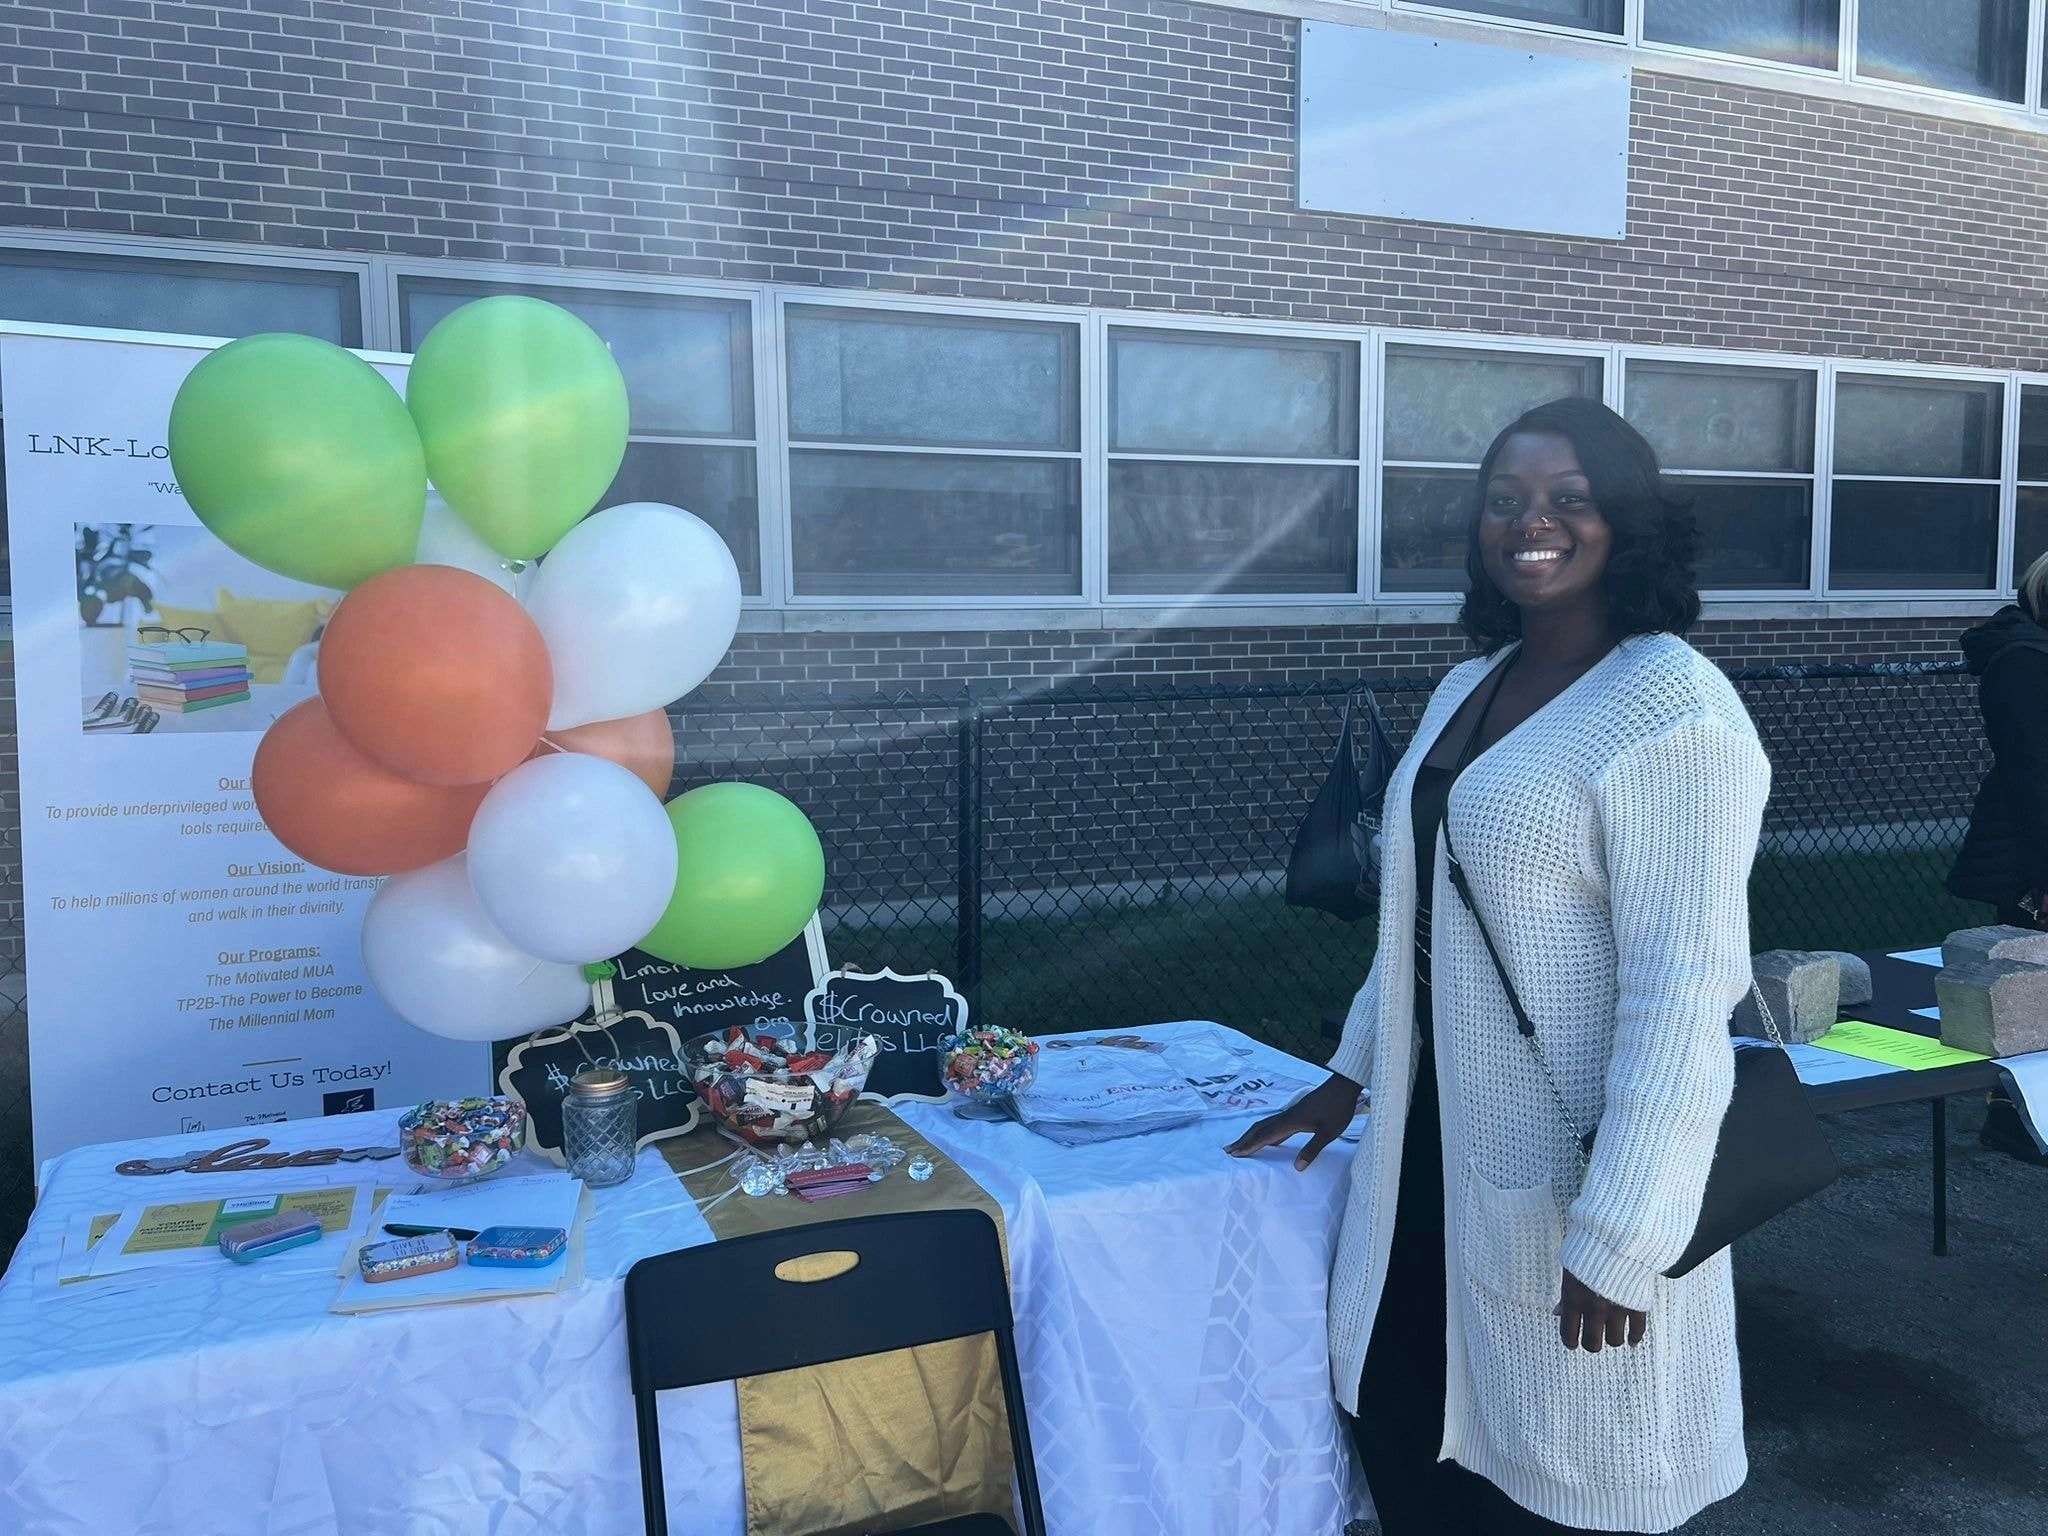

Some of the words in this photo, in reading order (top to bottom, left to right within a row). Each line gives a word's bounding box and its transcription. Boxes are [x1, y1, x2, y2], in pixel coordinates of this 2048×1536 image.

[218, 777, 245, 791] Our
[46, 806, 61, 819] To
[66, 804, 118, 821] provide
[123, 799, 228, 819] underprivileged
[180, 822, 211, 835] tools
[228, 863, 253, 877] Our
[257, 861, 306, 876] Vision:
[51, 896, 66, 909] To
[71, 894, 100, 910] help
[106, 891, 158, 907] millions
[163, 889, 177, 904] of
[180, 889, 228, 900] women
[233, 883, 278, 898] around
[282, 881, 302, 895] the
[306, 878, 340, 893] world
[188, 908, 213, 923] and
[217, 906, 248, 920] walk
[251, 906, 263, 918] in
[267, 902, 296, 917] their
[300, 900, 345, 915] divinity.
[217, 951, 244, 965] Our
[249, 946, 320, 962] Programs:
[206, 973, 231, 987] The
[235, 967, 299, 985] Motivated
[303, 964, 335, 978] MUA
[177, 994, 245, 1012] TP2B-The
[250, 990, 291, 1004] Power
[295, 989, 307, 1001] to
[311, 984, 363, 999] Become
[641, 983, 694, 1005] Love
[695, 974, 743, 993] and
[209, 1016, 234, 1031] The
[238, 1012, 300, 1028] Millennial
[303, 1008, 335, 1021] Mom
[152, 1077, 262, 1103] Contact
[270, 1072, 304, 1088] Us
[313, 1060, 392, 1084] Today!
[392, 1240, 413, 1250] GIVE
[416, 1238, 426, 1246] IT
[410, 1245, 429, 1254] GOD
